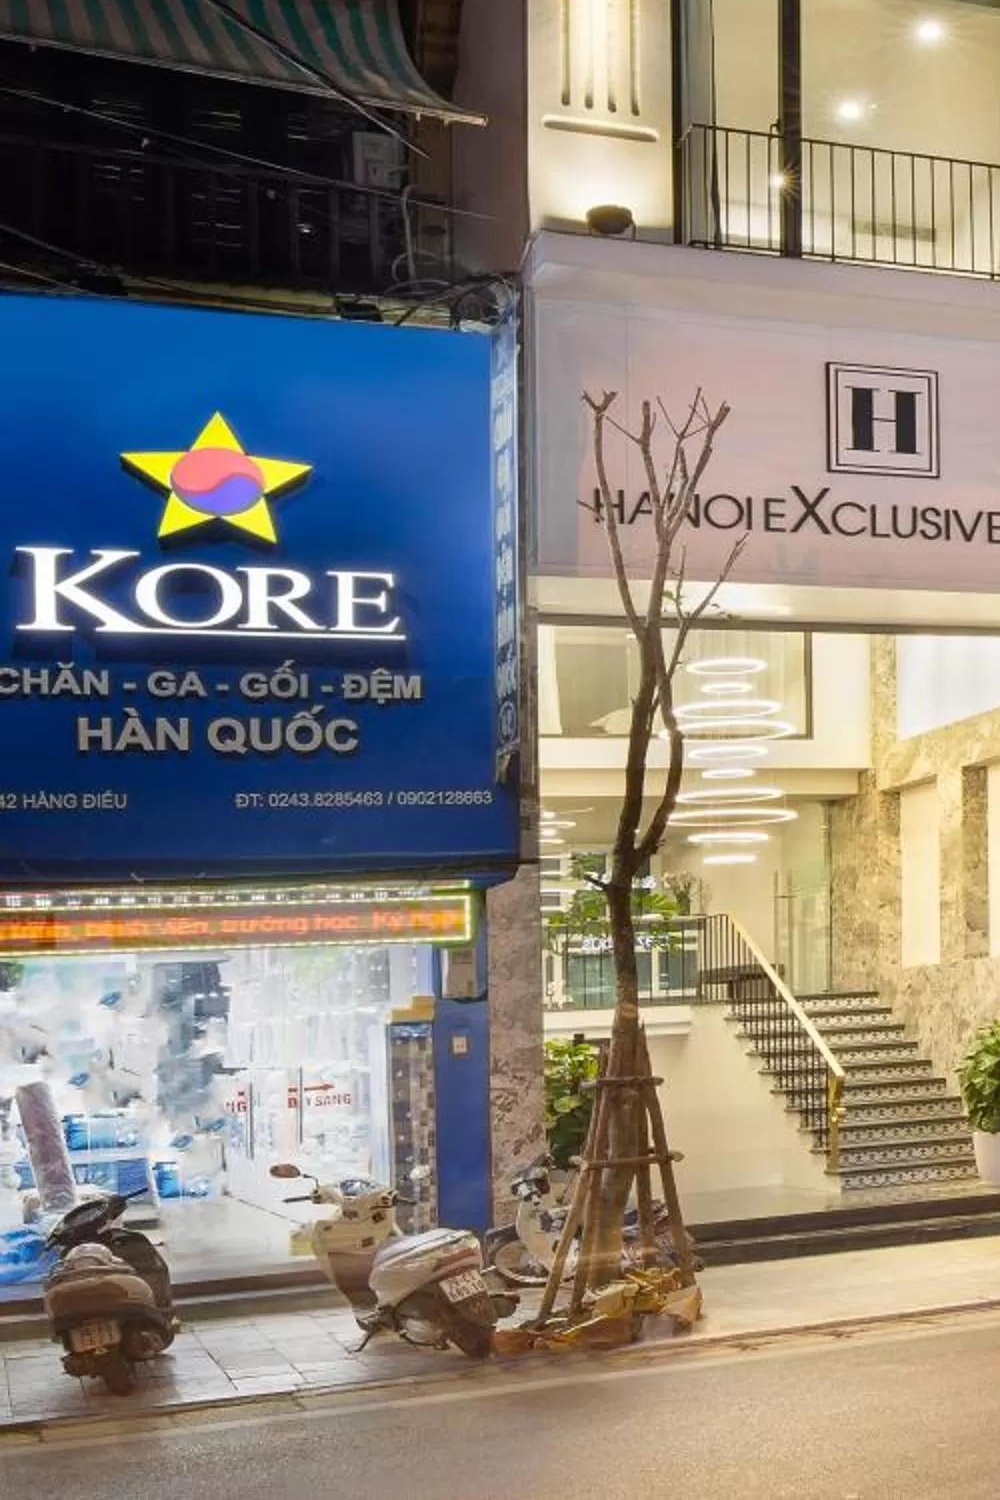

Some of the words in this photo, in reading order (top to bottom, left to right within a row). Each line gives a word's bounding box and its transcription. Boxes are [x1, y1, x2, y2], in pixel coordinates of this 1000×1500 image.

[15, 546, 405, 640] KORE
[0, 662, 109, 697] CHĂN
[147, 671, 207, 698] GA
[240, 660, 308, 698] GỐI
[342, 668, 422, 704] ĐỆM
[77, 708, 189, 752] HÀN
[207, 705, 359, 754] QUỐC
[23, 789, 77, 809] HÀNG
